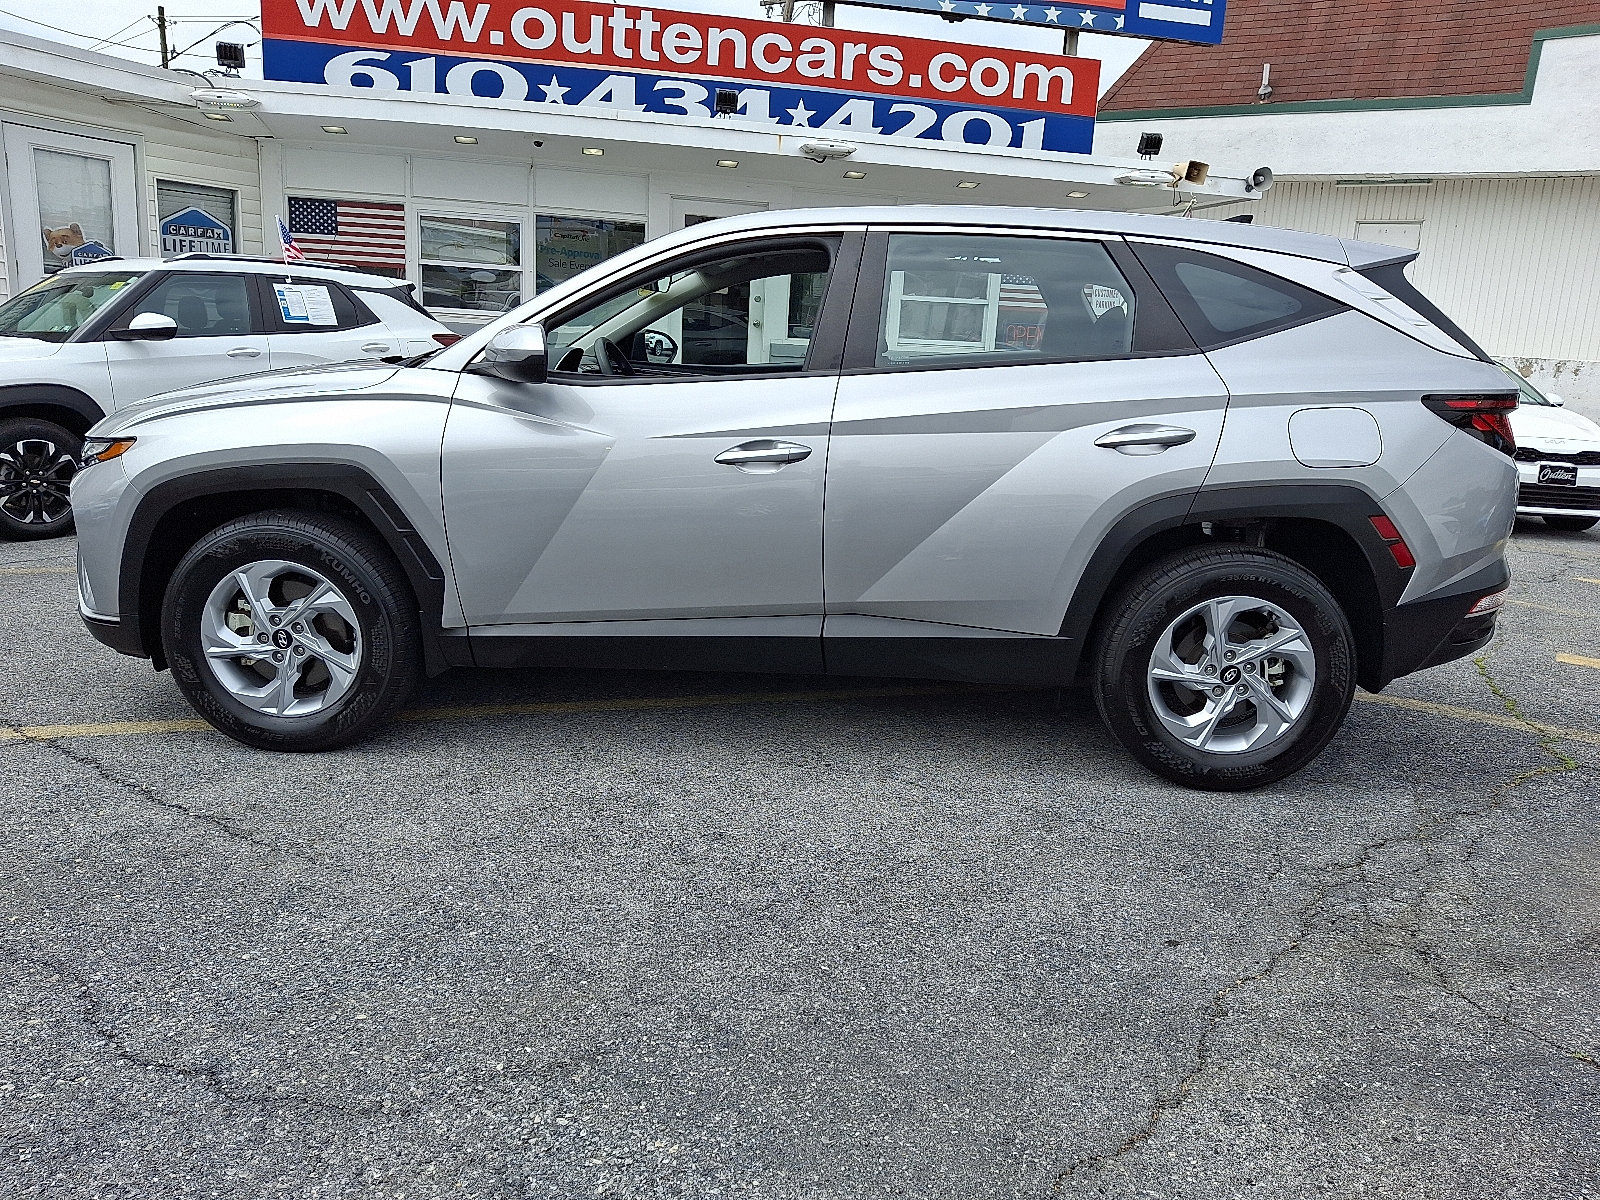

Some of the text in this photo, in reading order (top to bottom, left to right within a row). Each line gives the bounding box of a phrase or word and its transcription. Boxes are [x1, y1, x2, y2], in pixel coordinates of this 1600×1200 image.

[296, 0, 1073, 105] www.outtencars.com
[169, 225, 224, 239] CARFAX
[162, 237, 230, 254] LIFETIME
[539, 244, 602, 260] Pre-Approval
[548, 257, 567, 269] Sale
[1006, 324, 1043, 347] OPEN
[1539, 467, 1576, 481] Outten
[320, 552, 371, 605] KUMHO
